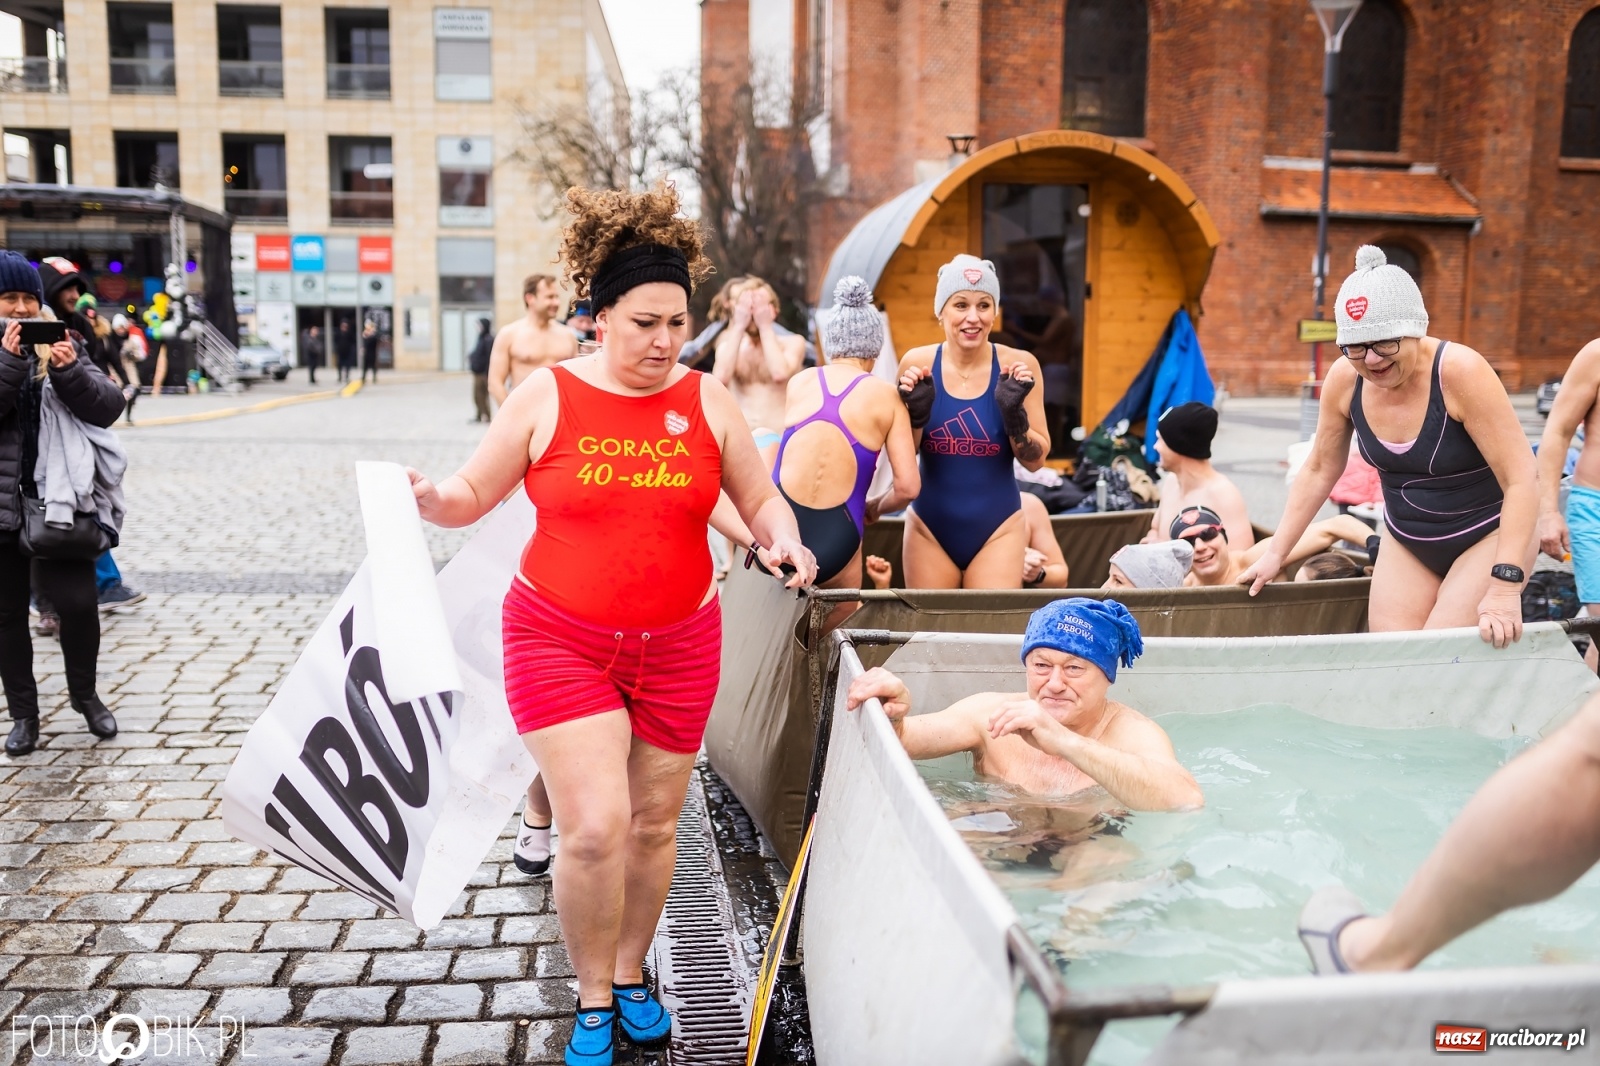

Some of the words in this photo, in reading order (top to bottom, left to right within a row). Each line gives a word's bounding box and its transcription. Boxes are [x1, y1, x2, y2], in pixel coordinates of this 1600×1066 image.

[577, 436, 690, 462] GORĄCA
[924, 438, 1001, 457] adidas
[576, 462, 613, 486] 40
[618, 461, 693, 488] -stka
[1057, 622, 1094, 642] DĘBOWA
[1064, 615, 1093, 630] MORSY
